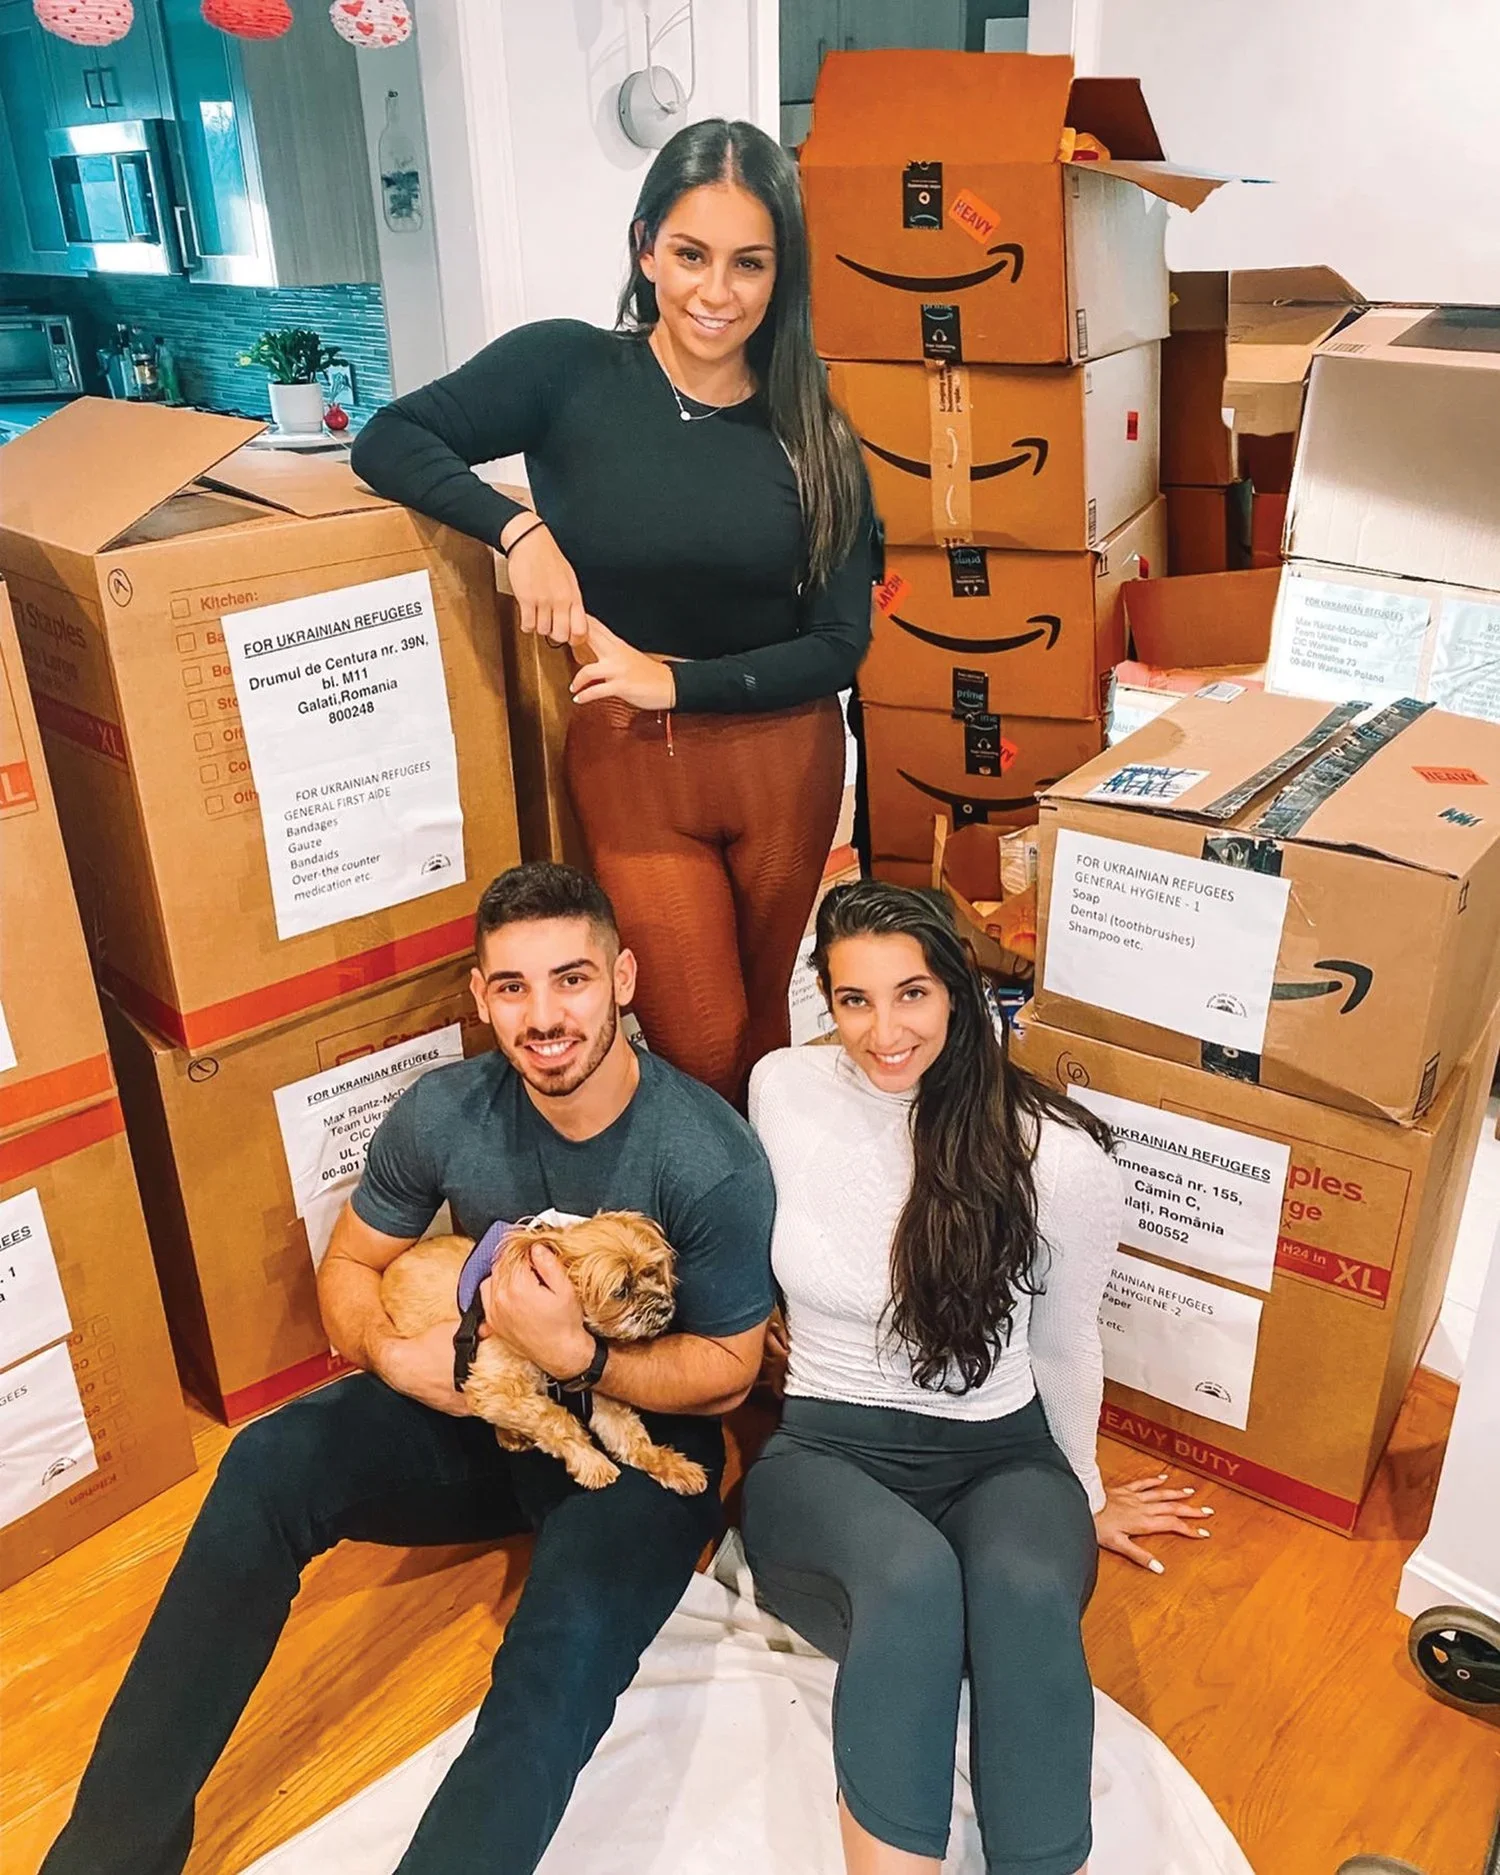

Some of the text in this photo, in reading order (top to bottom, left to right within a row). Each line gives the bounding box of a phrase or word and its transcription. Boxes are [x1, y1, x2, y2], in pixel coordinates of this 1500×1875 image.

[953, 200, 993, 237] HEAVY
[200, 591, 258, 611] Kitchen:
[877, 575, 903, 610] HEAVY
[243, 602, 422, 656] FOR UKRAINIAN REFUGEES
[1348, 637, 1368, 648] Love
[248, 667, 301, 692] Drumul
[304, 663, 321, 676] de
[325, 648, 378, 670] Centura
[381, 643, 398, 658] nr.
[322, 667, 369, 690] bl. M11
[1354, 669, 1384, 684] Poland
[956, 689, 984, 701] prime
[328, 701, 375, 725] 800248
[0, 770, 29, 804] L
[295, 760, 431, 802] FOR UKRAINIAN REFUGEES
[1420, 770, 1479, 783] HEAVY
[284, 786, 391, 822] GENERAL FIRST AIDE
[286, 817, 339, 838] Bandages
[288, 838, 322, 854] Gauze
[290, 849, 339, 870] Bandaids
[292, 854, 381, 886] Over-the counter
[294, 876, 352, 901] medication
[1076, 854, 1235, 902] FOR UKRAINIAN REFUGEES
[1072, 888, 1101, 905] Soap
[1074, 872, 1127, 894] GENERAL
[1130, 882, 1181, 908] HYGIENE
[1194, 901, 1200, 912] 1
[1068, 920, 1144, 951] Shampoo etc.
[1070, 904, 1196, 949] Dental (toothbrushes)
[307, 1049, 440, 1105] FOR UKRAINIAN REFUGEES
[323, 1112, 345, 1128] Max
[330, 1119, 361, 1137] Team
[349, 1127, 371, 1142] CIC
[339, 1147, 360, 1160] UL.
[1110, 1125, 1271, 1181] UKRAINIAN REFUGEES
[322, 1161, 360, 1181] 00-801
[1134, 1180, 1200, 1210] Cămin C,
[1187, 1180, 1206, 1194] nr.
[1212, 1186, 1242, 1206] 155,
[0, 1225, 31, 1248] EES
[1138, 1218, 1190, 1243] 800552
[1282, 1242, 1309, 1258] H24
[1334, 1259, 1382, 1296] XL
[1121, 1285, 1168, 1311] HYGIENE
[1170, 1306, 1181, 1317] -2
[1158, 1287, 1214, 1315] REFUGEES
[1106, 1319, 1125, 1333] etc.
[1174, 1438, 1240, 1476] DUTY
